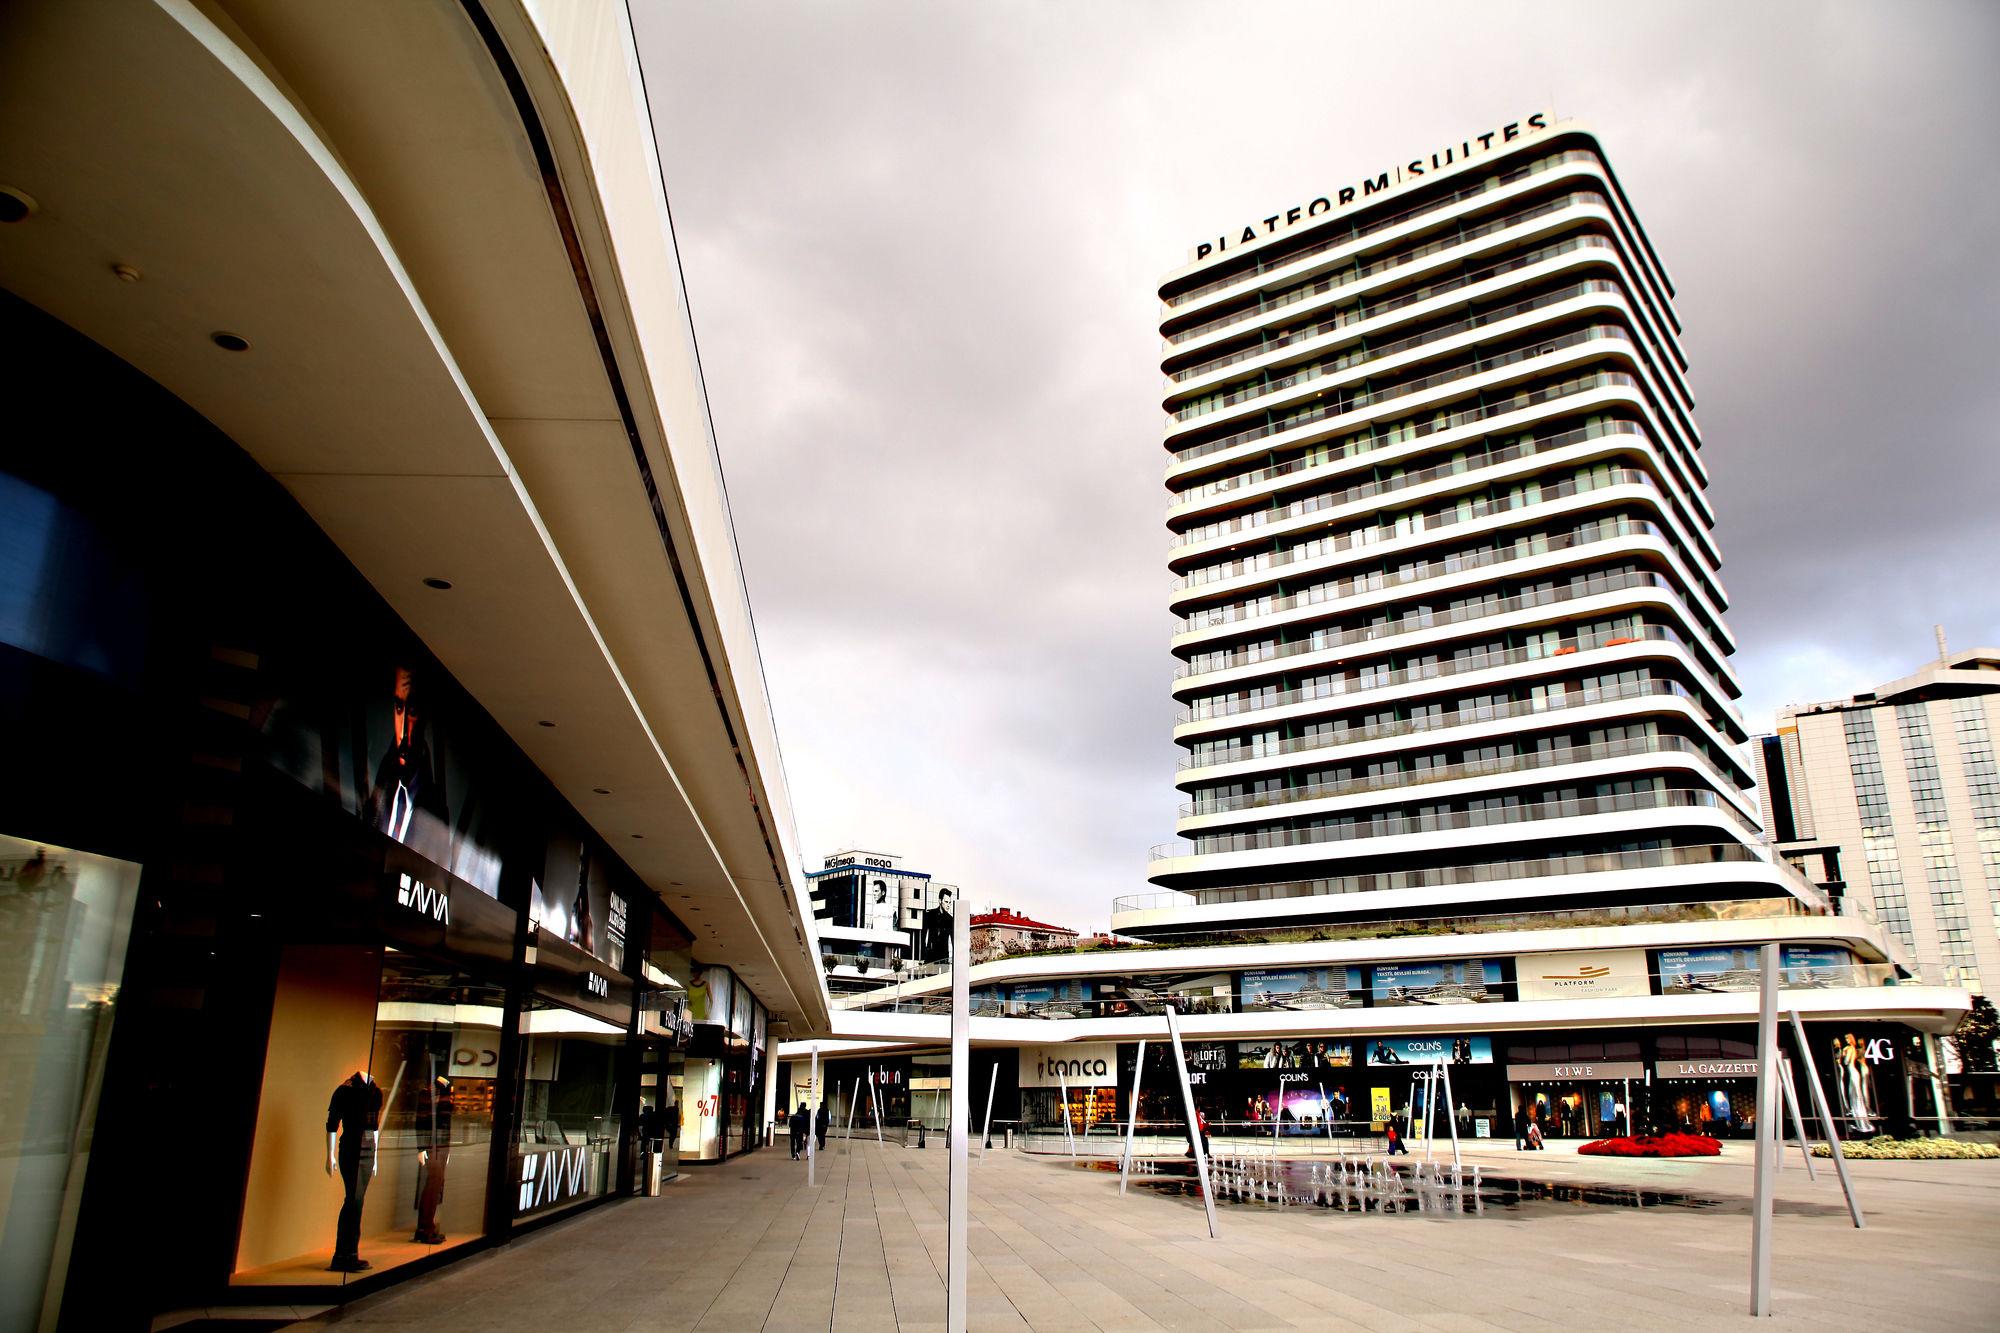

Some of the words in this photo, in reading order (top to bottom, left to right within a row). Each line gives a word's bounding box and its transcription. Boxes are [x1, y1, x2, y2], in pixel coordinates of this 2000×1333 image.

[1197, 173, 1389, 261] PLATFORM
[1408, 113, 1546, 177] SUITES
[409, 880, 449, 926] AVVA
[1407, 1041, 1442, 1052] COLIN'S
[1200, 1050, 1217, 1061] LOFT
[1047, 1056, 1107, 1077] tanca
[1554, 1066, 1593, 1077] KIWE
[1679, 1064, 1697, 1074] LA
[1698, 1063, 1758, 1073] GAZZETT
[1279, 1072, 1309, 1082] COLIN'S
[535, 1146, 587, 1207] AVVA
